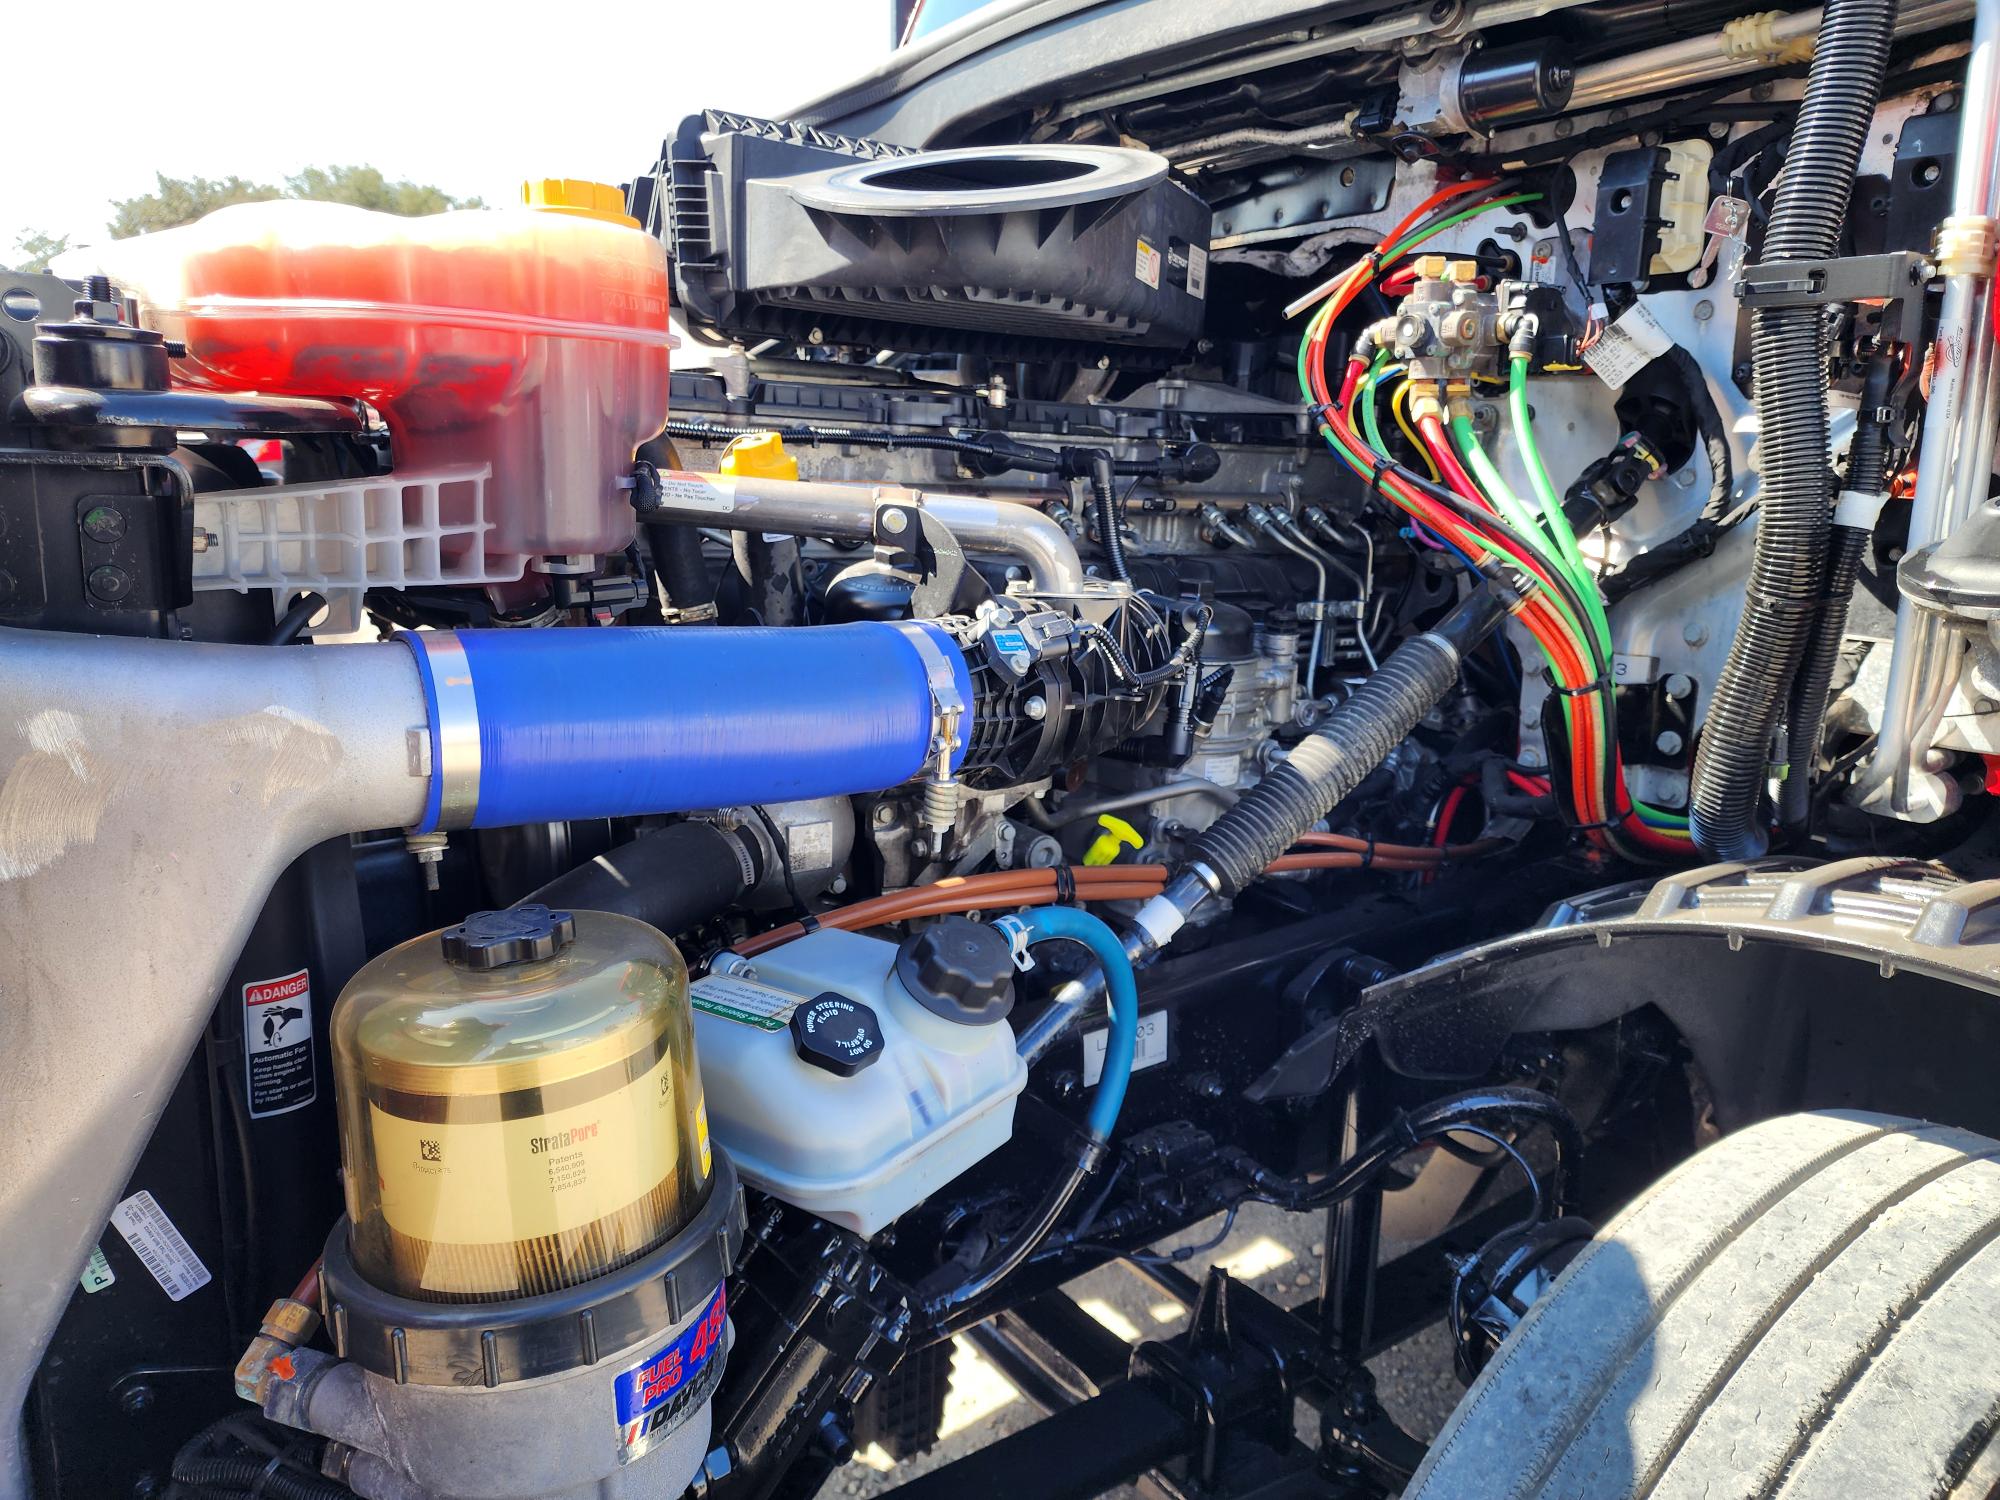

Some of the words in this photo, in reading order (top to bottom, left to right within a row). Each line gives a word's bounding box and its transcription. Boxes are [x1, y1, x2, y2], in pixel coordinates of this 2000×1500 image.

[263, 978, 307, 1000] DANGER
[713, 1006, 749, 1020] Steering
[806, 1010, 818, 1033] POWER
[815, 1001, 855, 1012] STEERING
[817, 1008, 839, 1024] FLUID
[835, 1028, 865, 1049] OVERFILL
[863, 1038, 873, 1049] DO
[253, 1050, 294, 1064] Automatic
[294, 1046, 306, 1054] Fan
[849, 1046, 864, 1056] NOT
[272, 1061, 293, 1070] hands
[548, 1152, 584, 1166] Patents
[94, 1276, 109, 1286] P
[636, 1348, 684, 1393] FUEL
[642, 1365, 682, 1408] PRO
